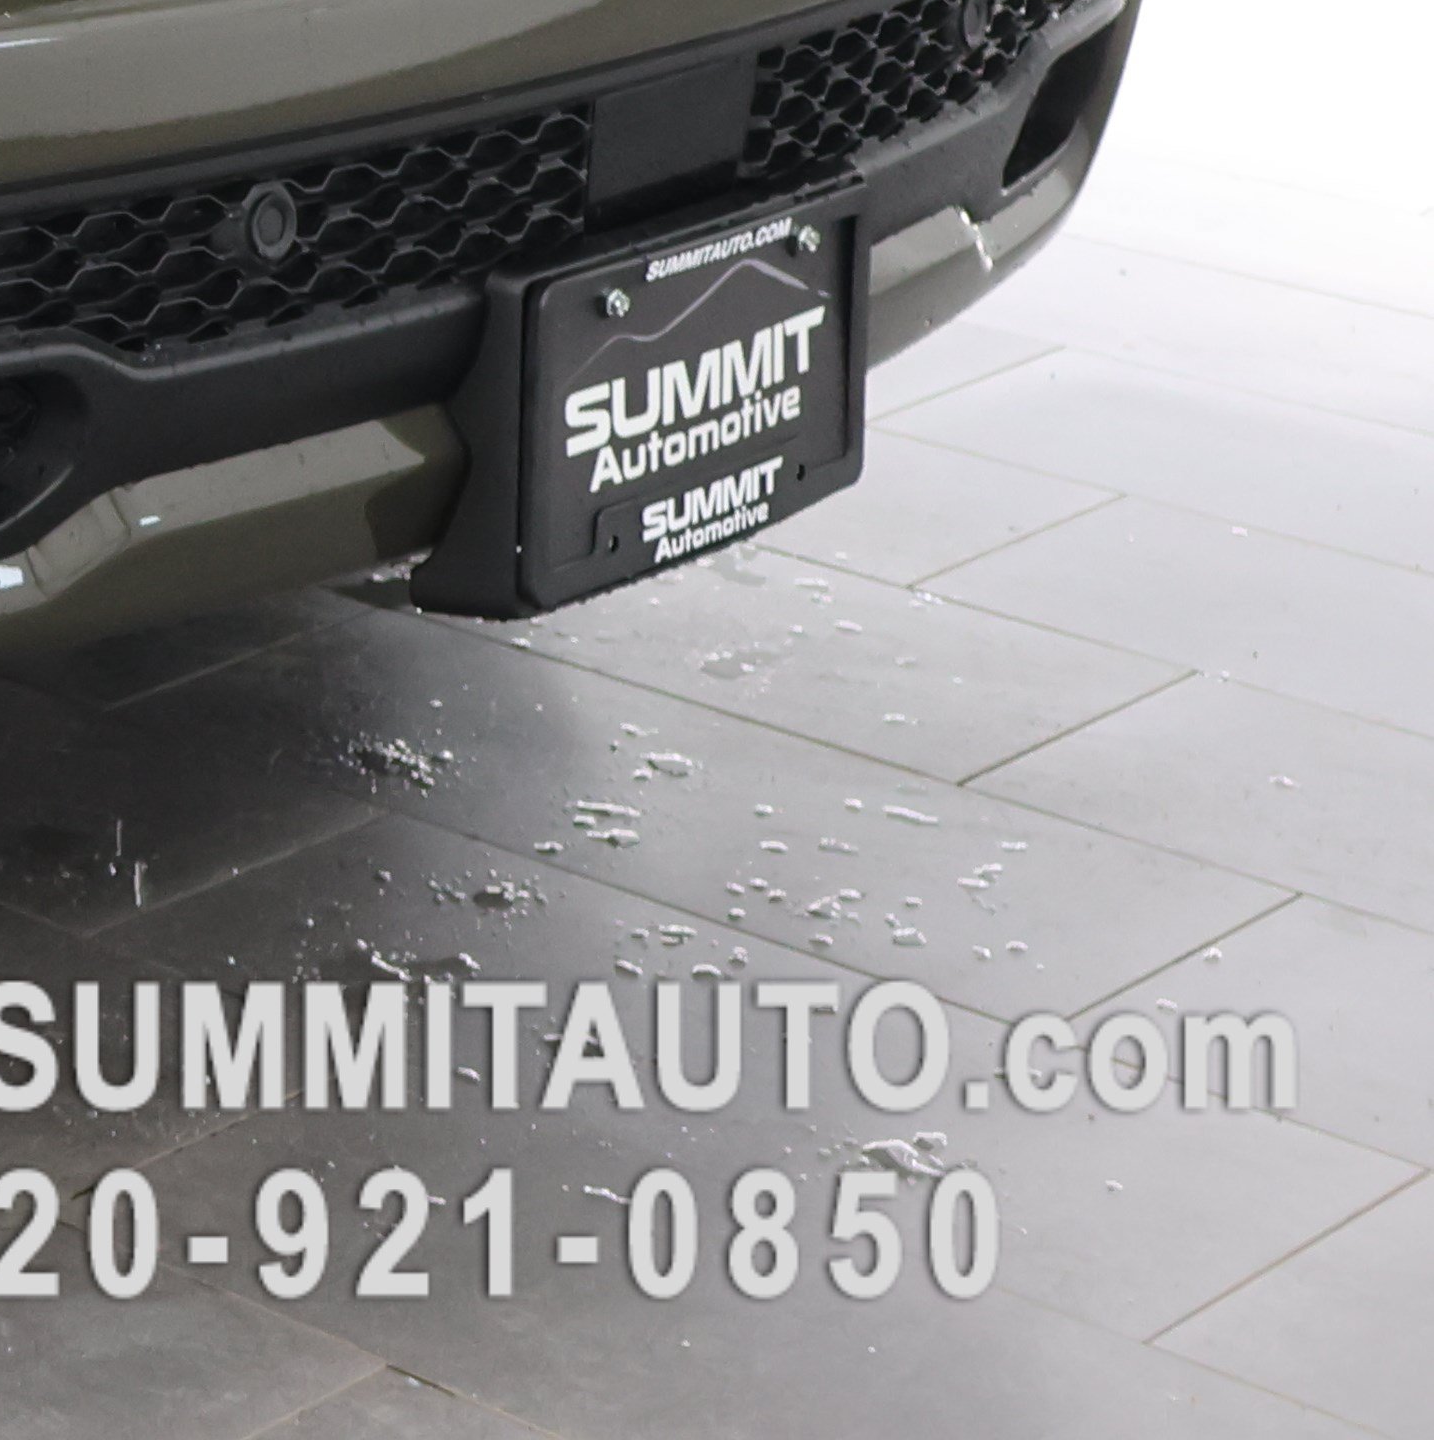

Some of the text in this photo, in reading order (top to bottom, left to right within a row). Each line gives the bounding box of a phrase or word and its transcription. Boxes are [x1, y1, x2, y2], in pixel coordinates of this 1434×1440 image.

[645, 217, 792, 282] SUMMITAUTO.COM
[565, 306, 826, 458] SUMMIT
[590, 386, 801, 493] Automotive
[642, 457, 783, 543] SUMMIT
[654, 501, 769, 563] Automotive
